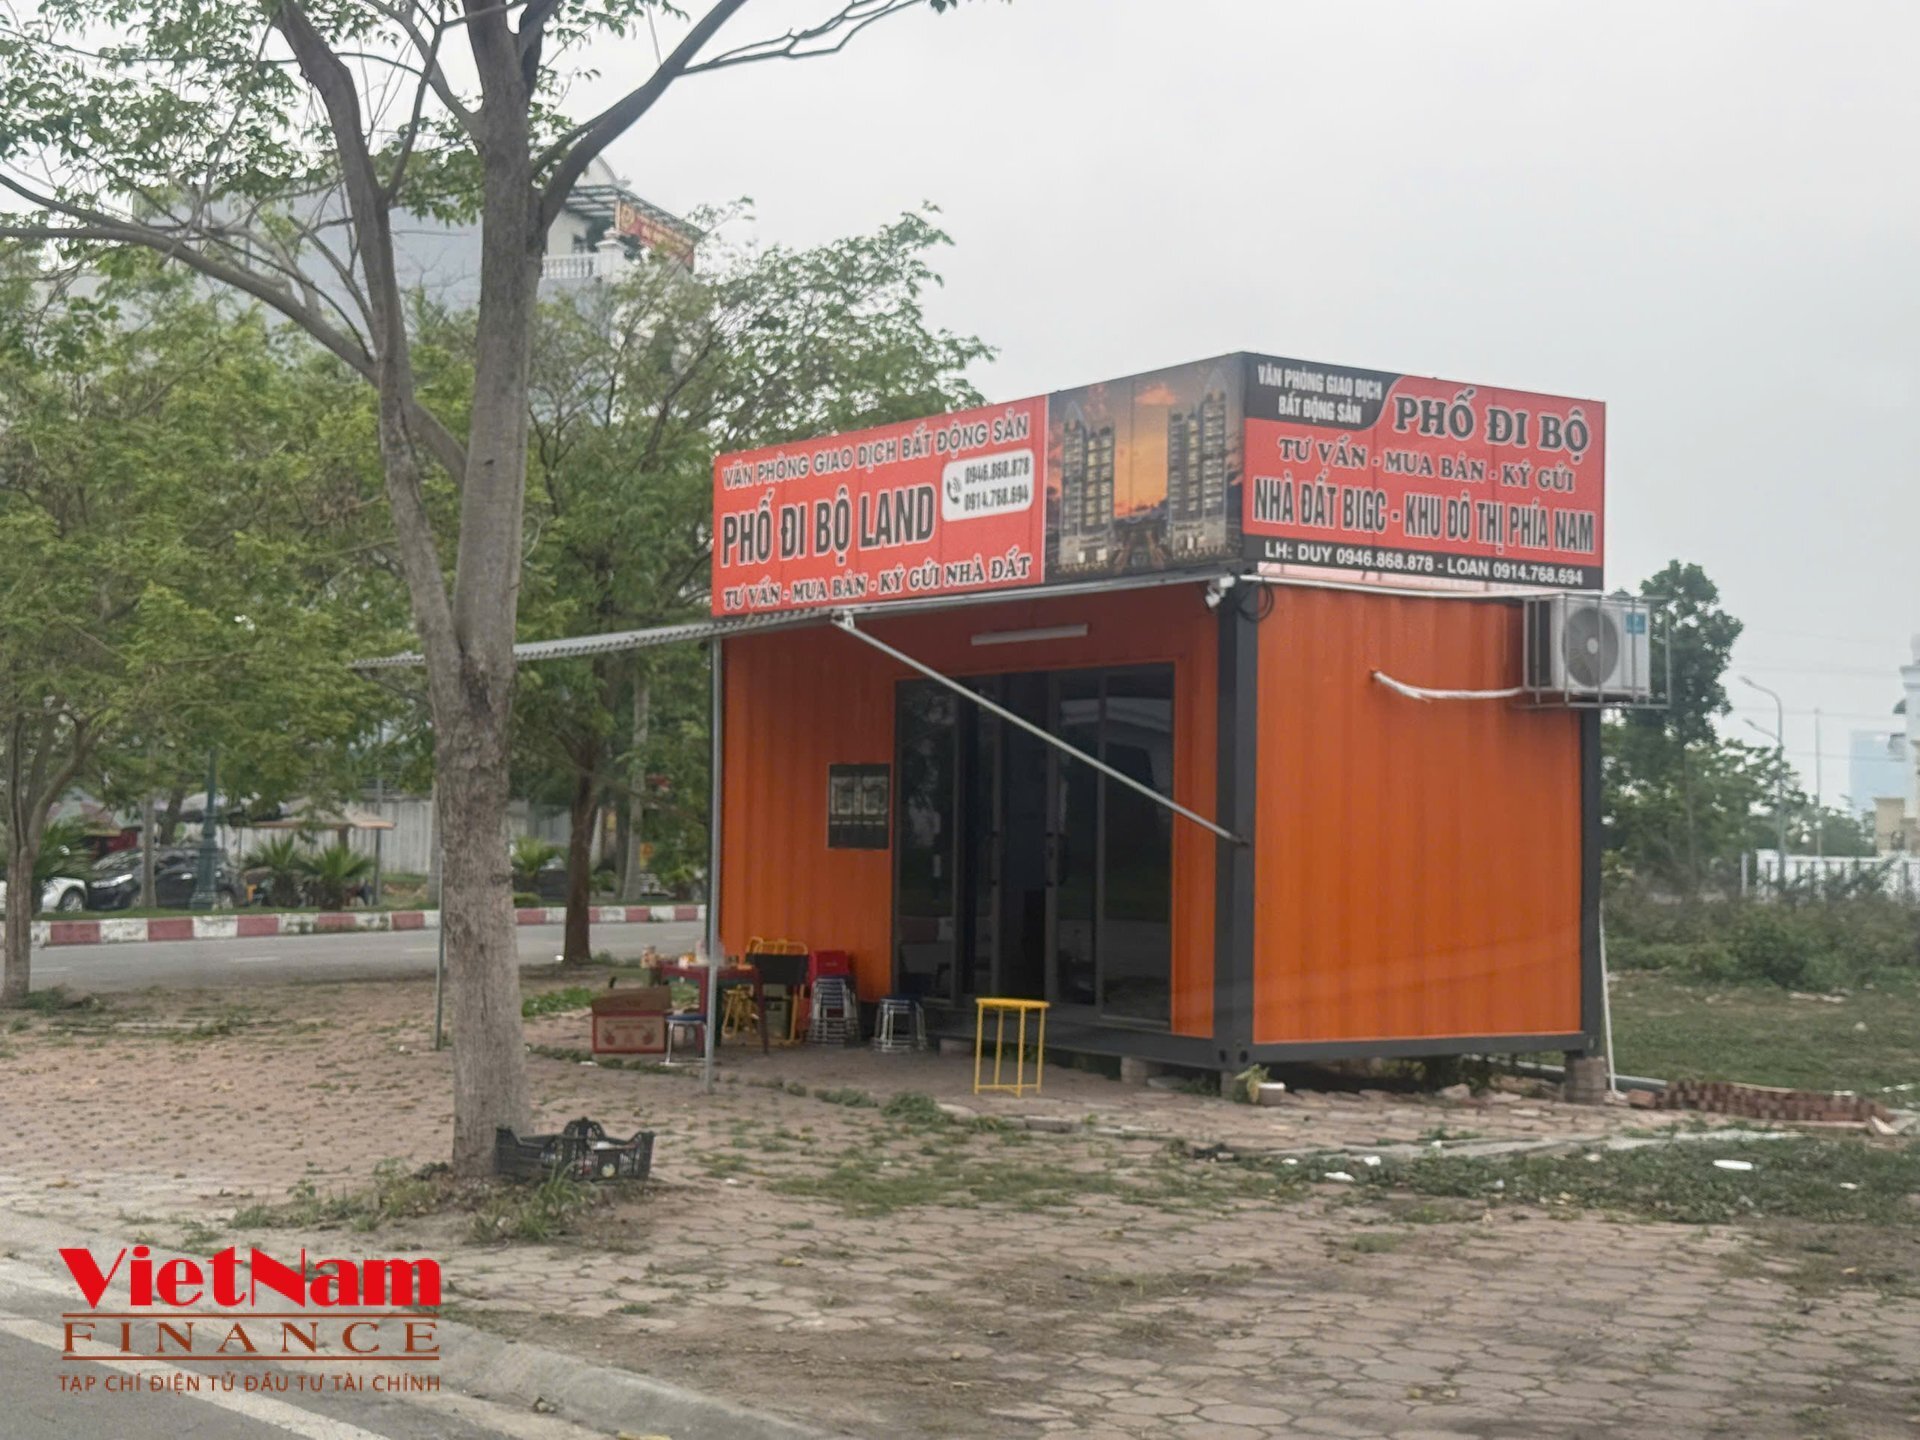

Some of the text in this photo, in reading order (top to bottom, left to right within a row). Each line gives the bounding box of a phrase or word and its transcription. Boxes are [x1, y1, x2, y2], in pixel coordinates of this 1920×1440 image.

[1278, 391, 1362, 424] BẤT ĐỘNG SẢN
[1284, 367, 1324, 393] PHÒNG
[1326, 375, 1354, 396] GIAO
[1354, 378, 1382, 403] DỊCH
[722, 408, 1030, 489] VĂN PHÒNG GIAO DỊCH BẤT ĐỘNG SẢN
[1393, 388, 1590, 464] PHỐ ĐI BỘ
[1279, 437, 1312, 463] TƯ
[1317, 434, 1367, 470] VẤN
[1384, 450, 1433, 477] MUA
[1439, 453, 1486, 482] BÁN
[1537, 462, 1575, 493] GỬI
[721, 482, 936, 567] PHỐ ĐI BỘ LAND
[1253, 469, 1295, 524] NHÀ
[1299, 467, 1338, 529] ĐẤT
[1342, 486, 1387, 533] BIGC
[1405, 493, 1442, 540] KHU
[1446, 490, 1471, 543] ĐÔ
[1476, 501, 1504, 553] THỊ
[1508, 498, 1549, 550] PHÍA
[1554, 509, 1596, 554] NAM
[725, 583, 745, 609] TƯ
[748, 575, 782, 608] VẤN
[792, 578, 828, 603] MUA
[831, 569, 868, 599] BÁN
[908, 557, 941, 591] GỬI
[944, 553, 985, 586] NHÀ
[990, 545, 1032, 581] ĐẤT
[1264, 540, 1293, 560] LH:
[1297, 544, 1333, 563] DUY
[1335, 549, 1434, 573] 0946.868.878
[1446, 557, 1490, 577] LOAN
